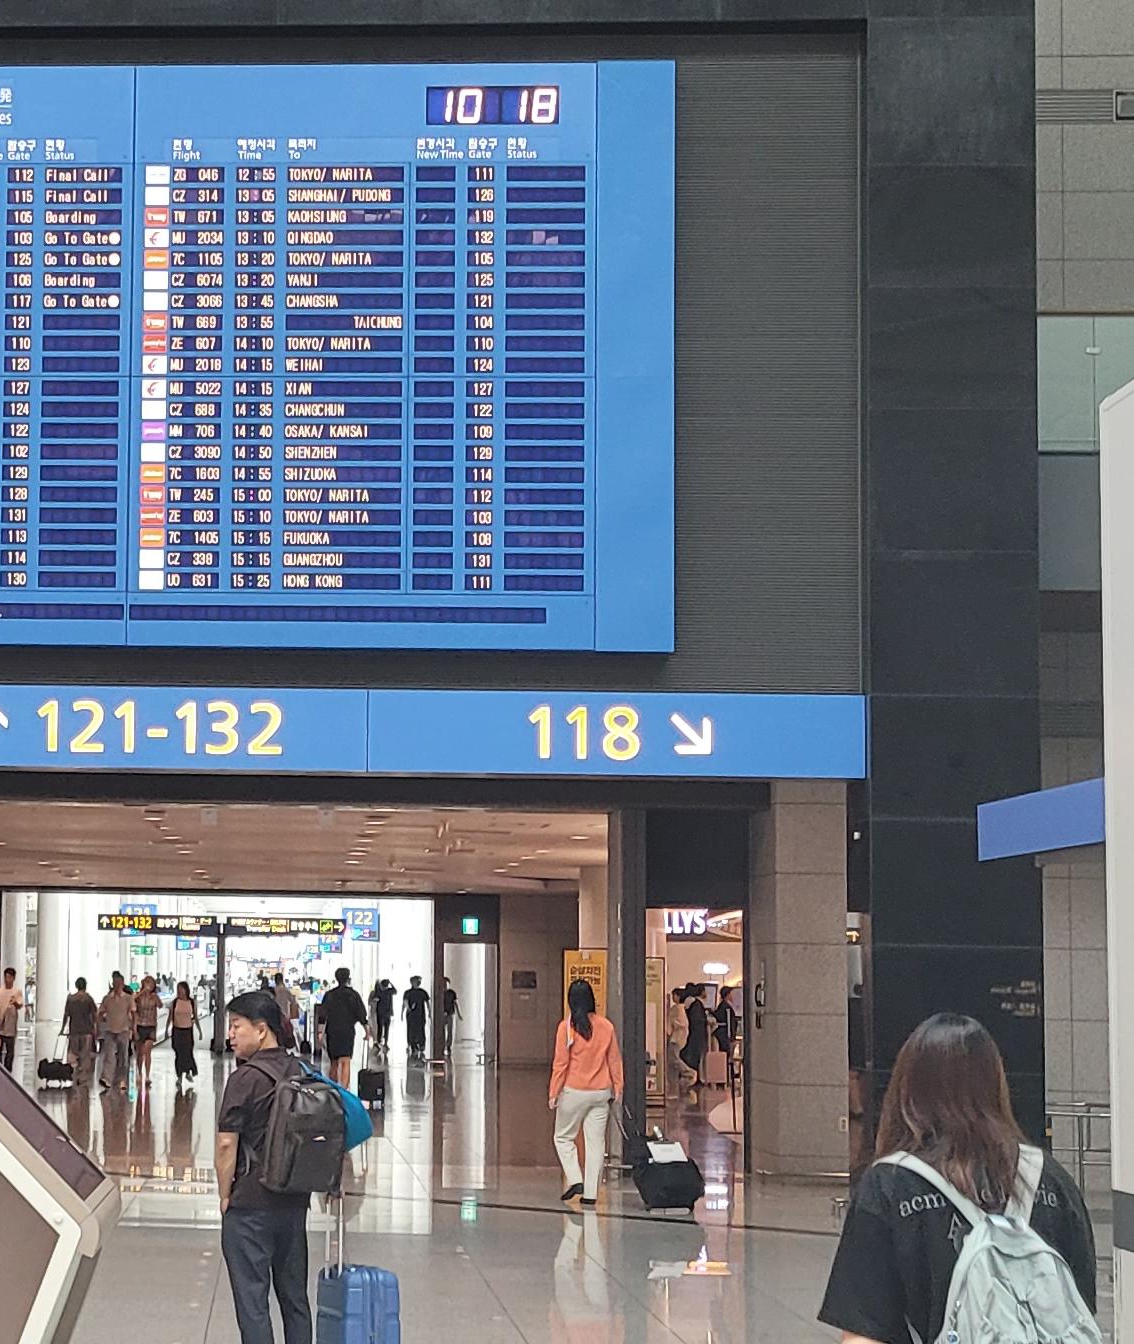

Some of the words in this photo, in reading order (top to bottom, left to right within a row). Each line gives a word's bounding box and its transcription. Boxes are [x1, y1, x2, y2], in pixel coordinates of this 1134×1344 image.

[444, 88, 483, 124] 10
[519, 88, 558, 124] 18
[7, 151, 31, 161] Gate
[45, 151, 75, 161] Status
[173, 151, 201, 162] Flight
[237, 151, 262, 160] Time
[288, 151, 301, 160] To
[416, 150, 439, 160] New
[440, 150, 464, 160] Time
[468, 150, 492, 160] Gate
[507, 150, 537, 160] Status
[14, 168, 34, 182] 112
[46, 168, 77, 182] Final
[83, 168, 109, 182] Call
[198, 168, 219, 182] 046
[289, 167, 327, 183] TOKYO/
[332, 167, 373, 181] NARITA
[475, 167, 493, 181] 111
[14, 189, 34, 203] 115
[45, 189, 77, 203] Final
[83, 189, 108, 203] Call
[288, 188, 347, 204] SHANGHAI/
[352, 188, 392, 202] PUDONG
[45, 210, 97, 225] Boarding
[287, 209, 347, 224] KAOHSIUNG
[44, 231, 58, 245] Go
[63, 231, 78, 245] To
[82, 231, 109, 245] Gate
[287, 231, 334, 245] QINGDAO
[44, 252, 58, 266] Go
[63, 252, 77, 266] To
[82, 252, 108, 266] Gate
[288, 251, 326, 267] TOKYO/
[331, 252, 372, 266] NARITA
[44, 273, 96, 288] Boarding
[287, 273, 318, 287] YANJI
[43, 294, 57, 308] Go
[62, 294, 77, 308] To
[81, 294, 108, 308] Gate
[286, 294, 339, 308] CHANGSHA
[353, 315, 403, 329] TAICHUNG
[286, 336, 325, 352] TOKYO/
[330, 336, 371, 351] NARITA
[285, 358, 323, 372] WEIHAI
[285, 382, 312, 395] XIAN
[284, 403, 345, 417] CHANGCHUN
[284, 424, 324, 439] OSAKA/
[329, 424, 368, 438] KANSAI
[284, 445, 337, 460] SHENZHEN
[284, 467, 337, 481] SHIZUOKA
[284, 488, 323, 504] TOKYO/
[328, 488, 370, 503] NARITA
[284, 509, 323, 525] TOKYO/
[328, 510, 369, 524] NARITA
[283, 531, 330, 545] FUKUOKA
[283, 553, 343, 567] GUANGZHOU
[7, 572, 27, 586] 130
[167, 573, 181, 587] UO
[192, 573, 212, 587] 631
[283, 574, 310, 588] HONG
[315, 574, 343, 588] KONG
[472, 575, 490, 589] 111
[37, 699, 283, 755] 121-132
[528, 705, 642, 761] 118
[111, 916, 152, 929] 121-132
[346, 911, 374, 925] 122
[899, 1189, 948, 1218] acm
